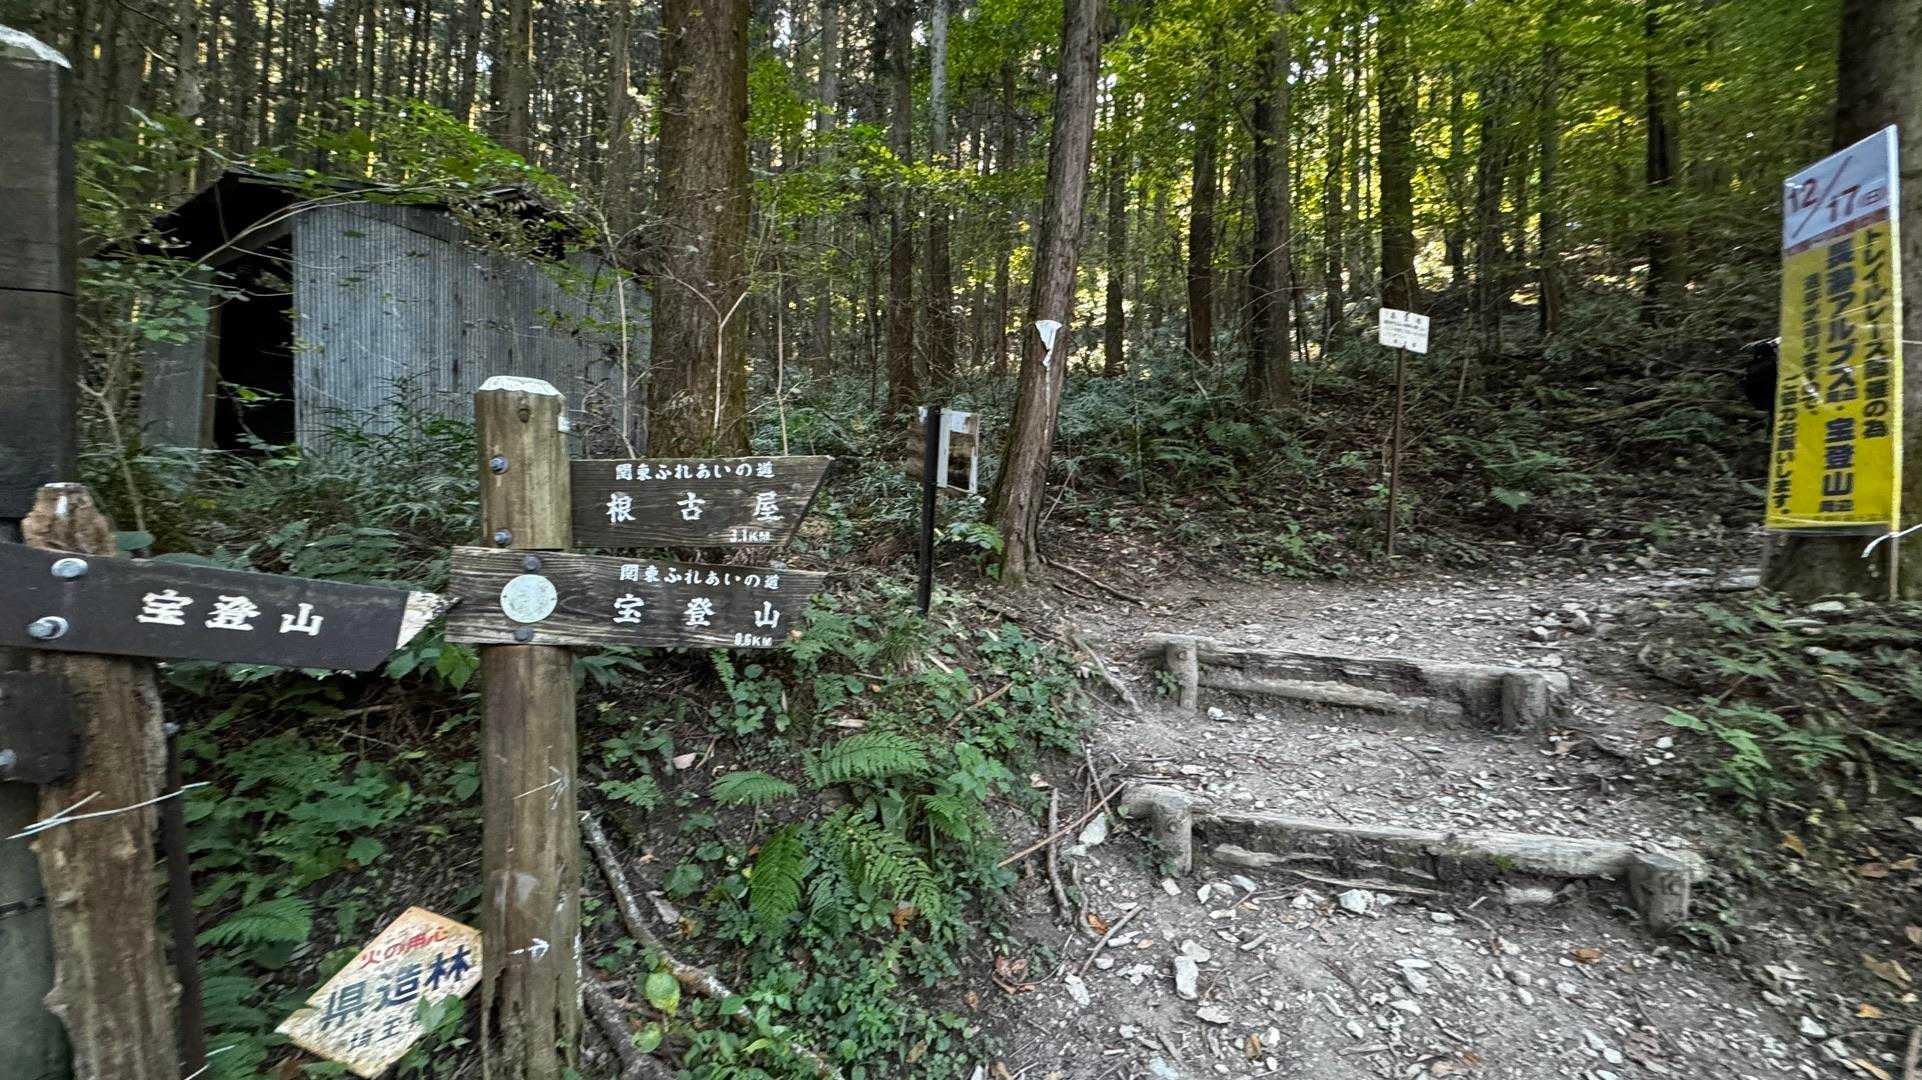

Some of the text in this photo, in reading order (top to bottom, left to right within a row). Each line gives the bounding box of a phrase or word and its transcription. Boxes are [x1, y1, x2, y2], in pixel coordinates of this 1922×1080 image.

[615, 461, 775, 482] 関東ふれあいの道
[605, 491, 785, 526] 根古屋
[619, 563, 780, 590] 関東ふれあいの道
[136, 589, 324, 636] 宝登山
[612, 593, 780, 628] 宝登山
[320, 944, 471, 1031] 県造林
